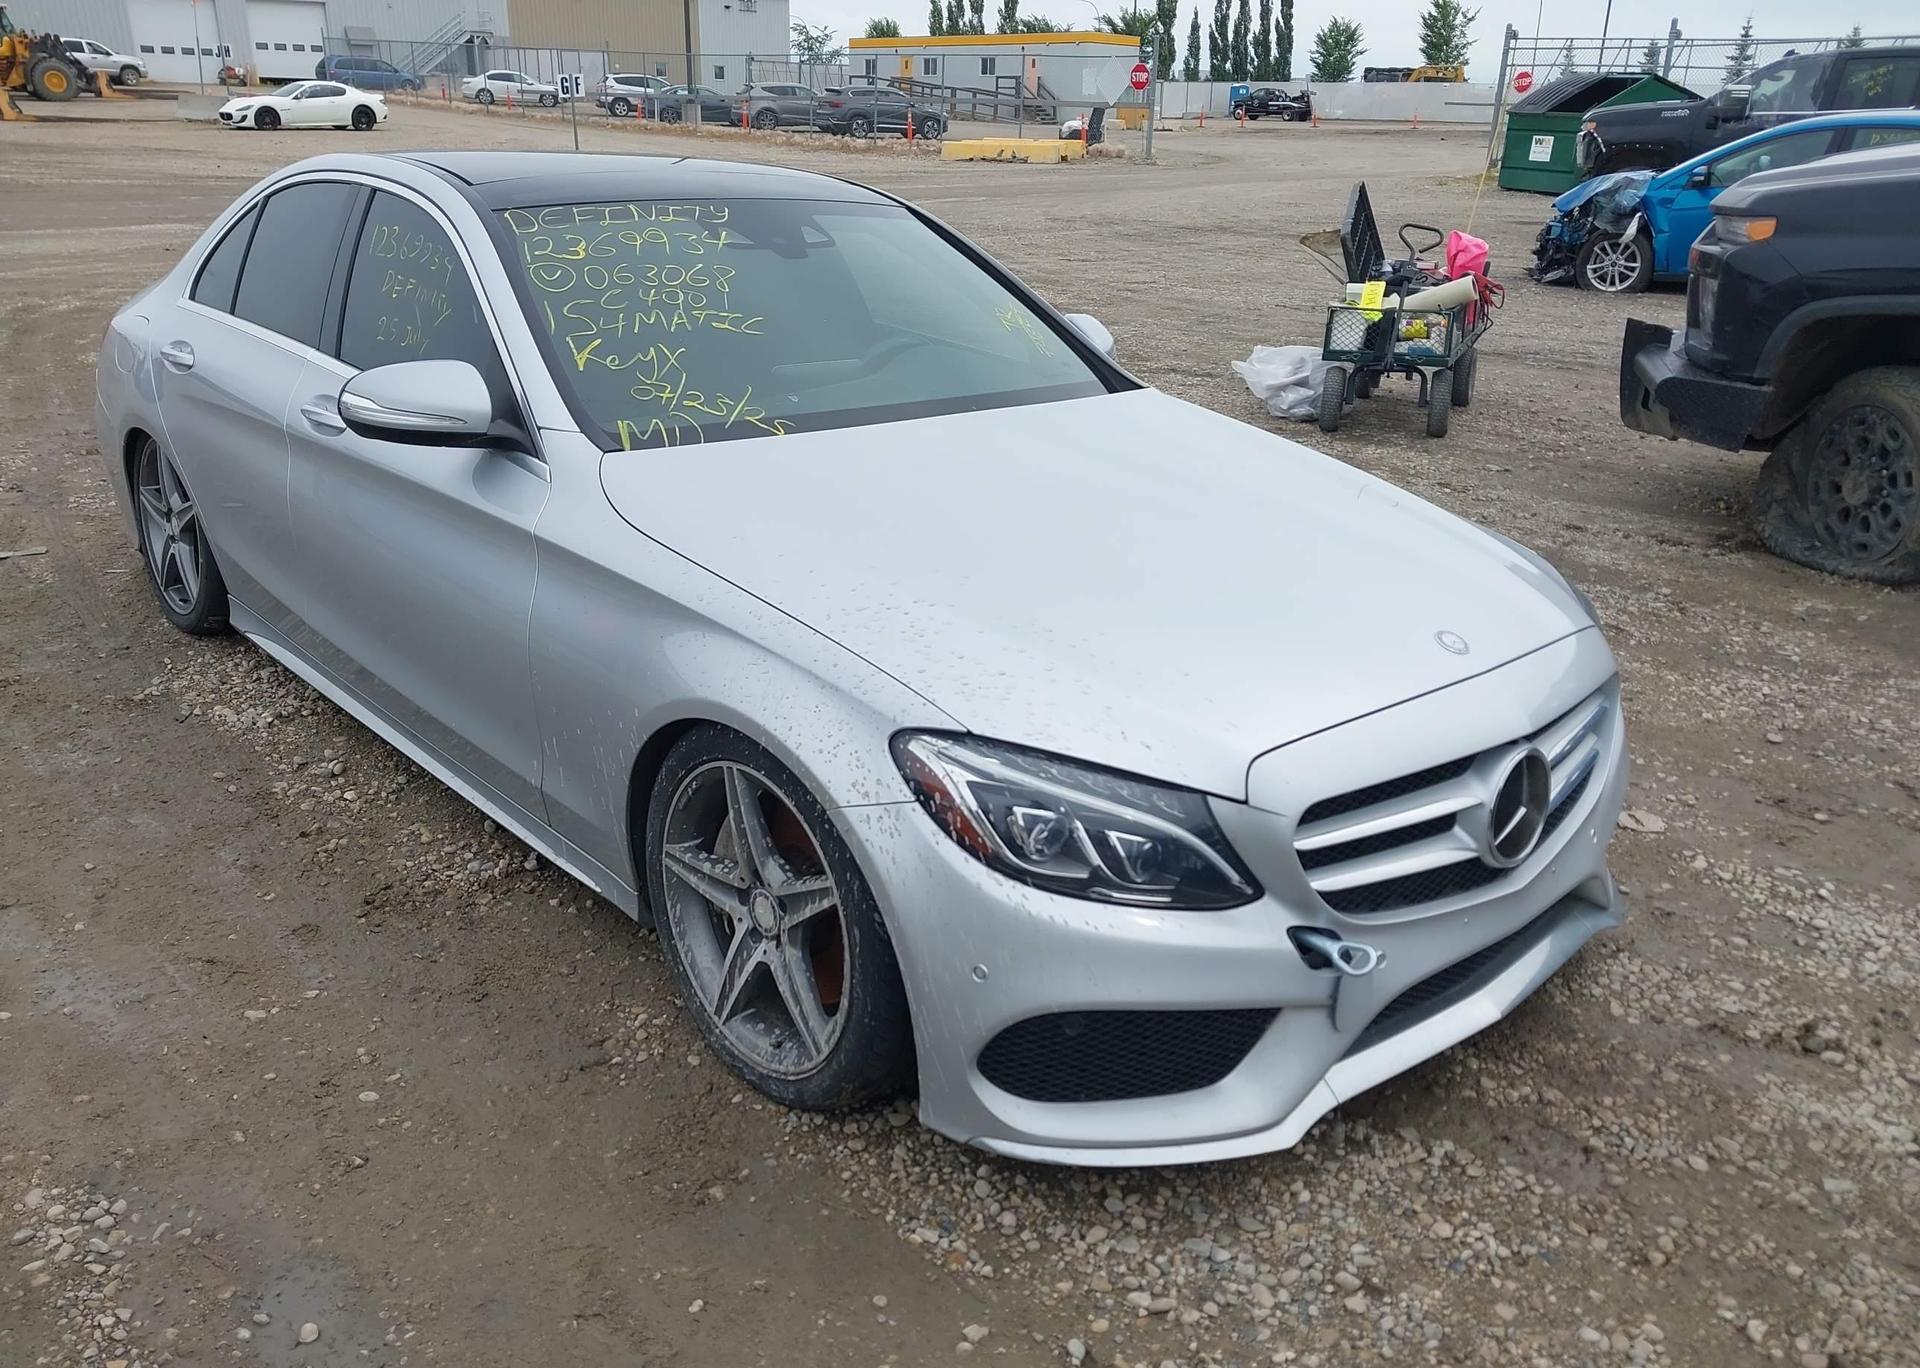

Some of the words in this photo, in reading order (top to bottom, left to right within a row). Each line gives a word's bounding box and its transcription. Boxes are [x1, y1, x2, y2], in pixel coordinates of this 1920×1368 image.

[560, 76, 570, 95] G
[574, 76, 581, 95] F
[1131, 71, 1149, 82] STOP
[1514, 77, 1532, 87] STOP
[504, 204, 729, 235] DEFINITY
[524, 228, 729, 263] 12369934
